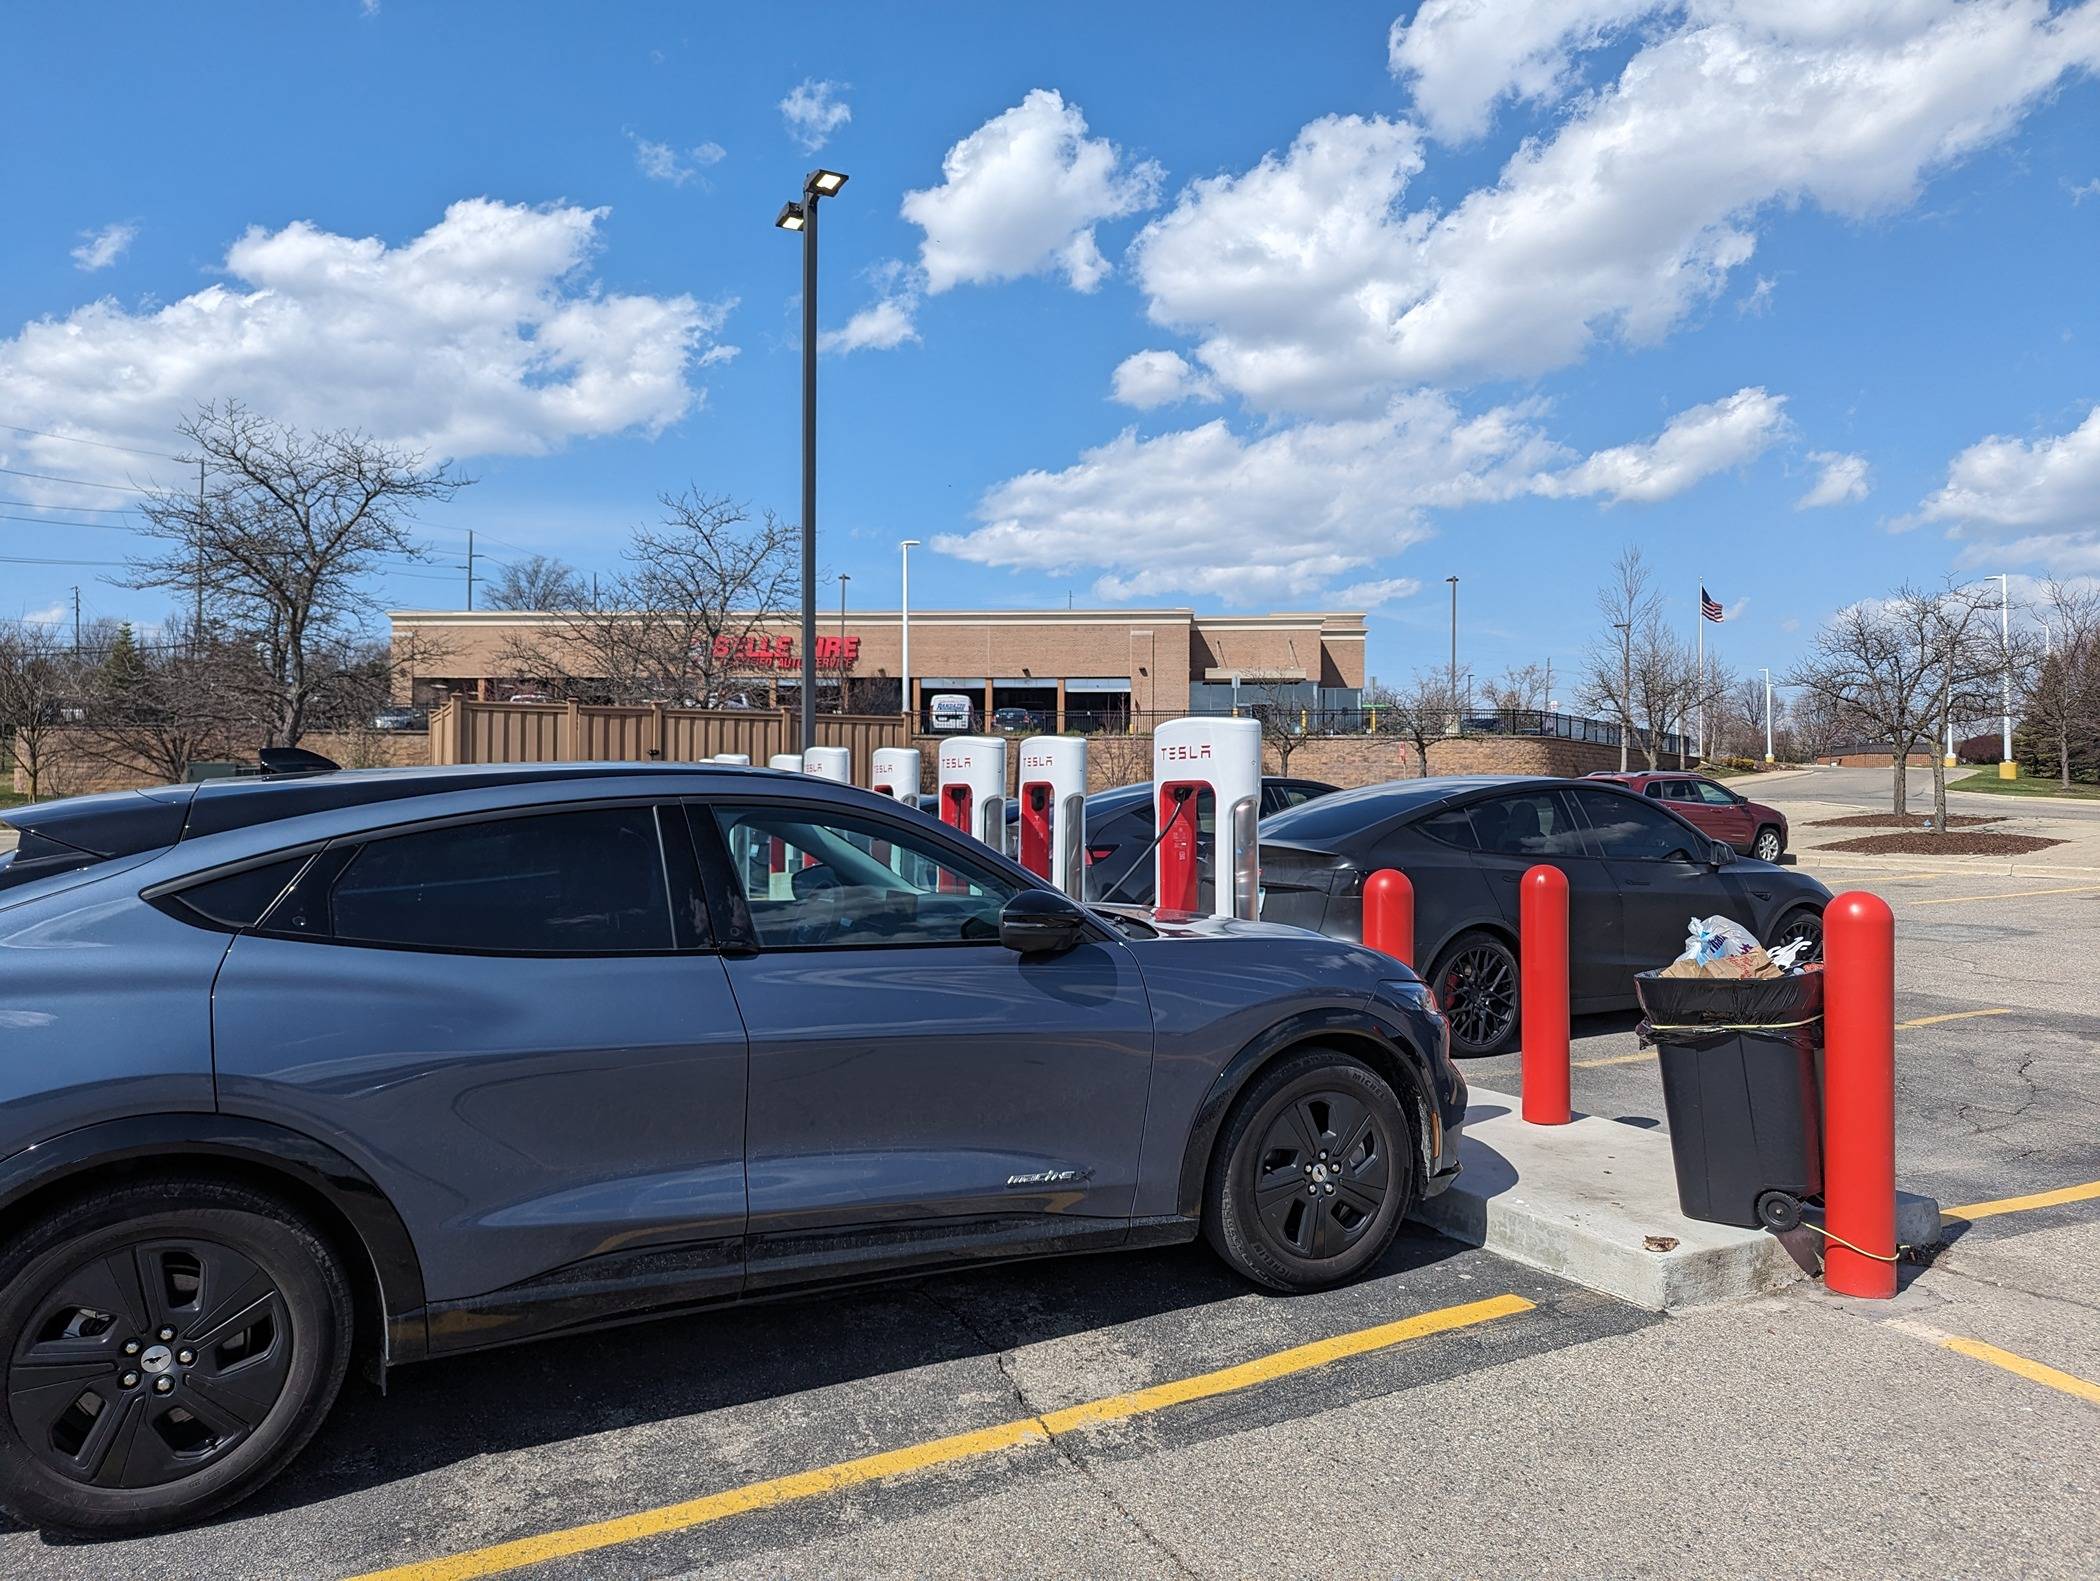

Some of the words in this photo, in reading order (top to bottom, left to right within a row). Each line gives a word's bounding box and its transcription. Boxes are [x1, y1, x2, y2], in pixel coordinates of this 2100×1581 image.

[813, 635, 860, 658] IRE
[815, 656, 854, 669] ERVIE
[1161, 744, 1211, 761] TESLA
[805, 763, 823, 773] ESLA
[941, 757, 971, 769] TESLA
[1022, 755, 1053, 768] TESLA
[873, 764, 893, 774] ESLA
